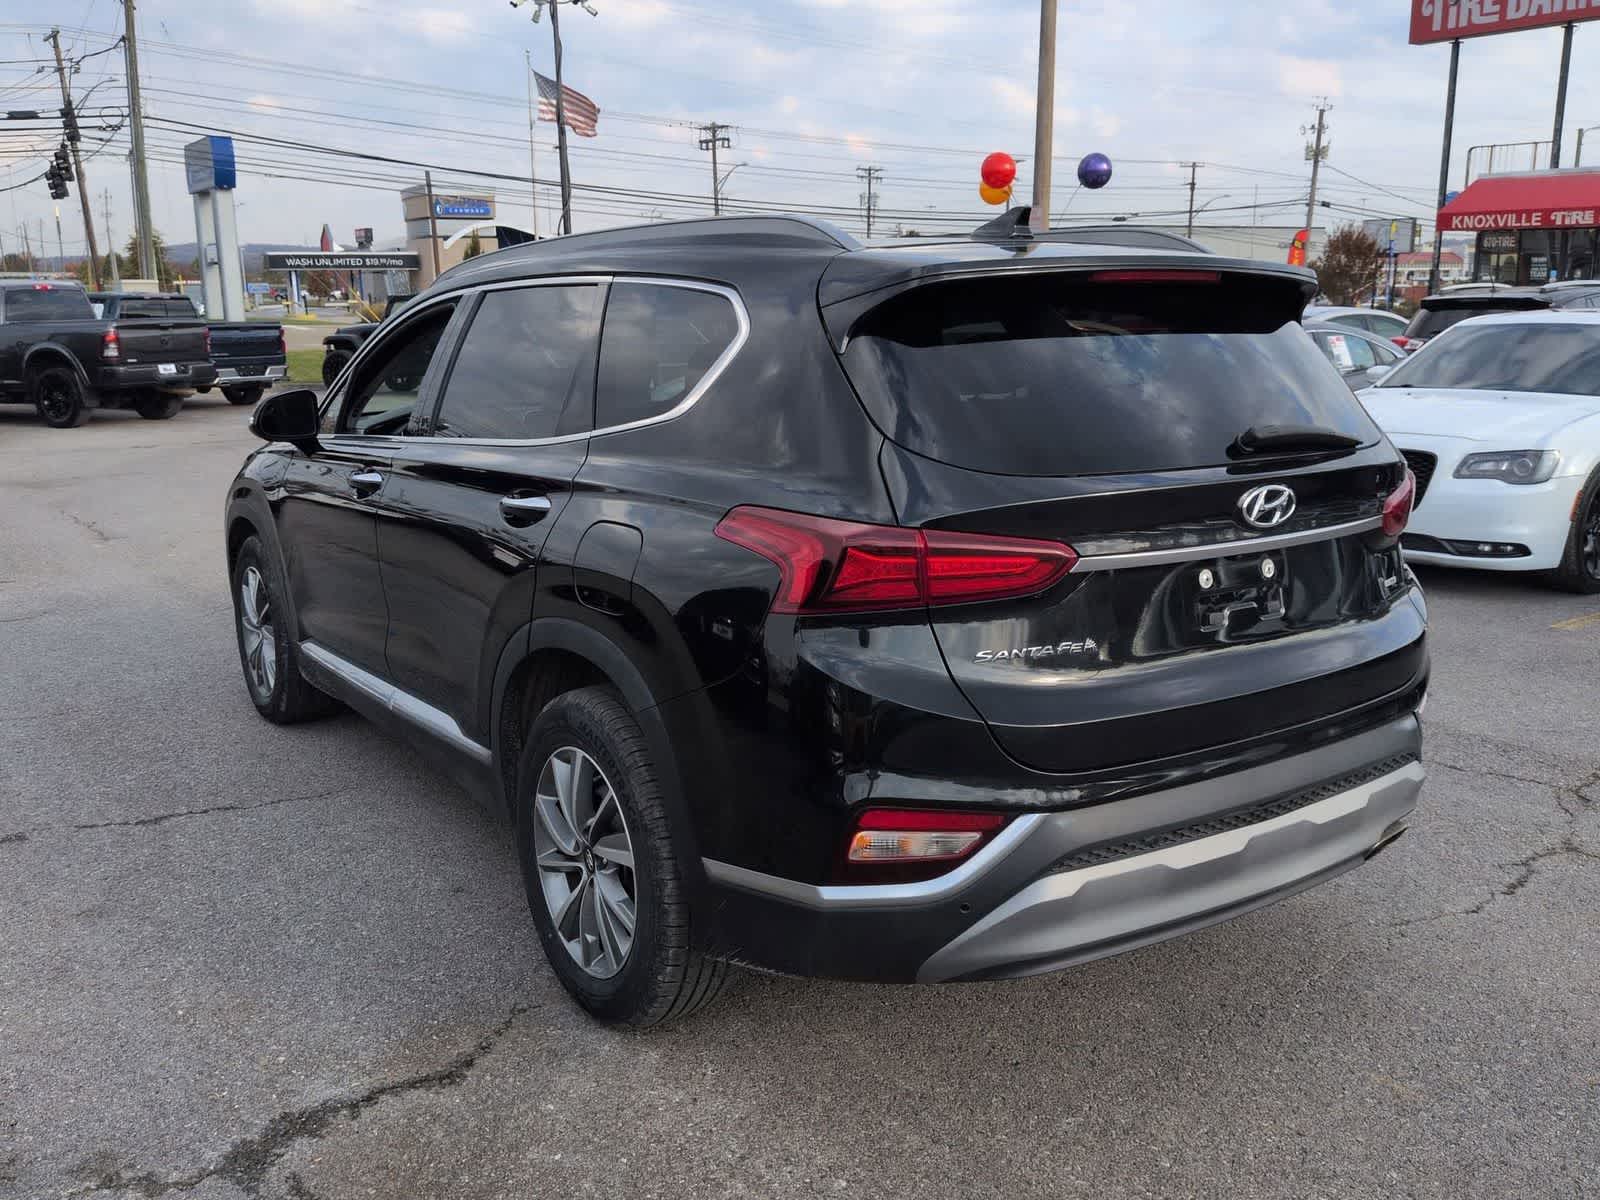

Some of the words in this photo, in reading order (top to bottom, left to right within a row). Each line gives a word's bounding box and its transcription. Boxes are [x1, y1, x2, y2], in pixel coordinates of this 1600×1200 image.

[1452, 212, 1541, 228] KNOXVILLE
[286, 258, 313, 266] WASH
[315, 258, 363, 266] UNLIMITED
[974, 645, 1054, 664] SANTA
[1057, 641, 1084, 654] FE
